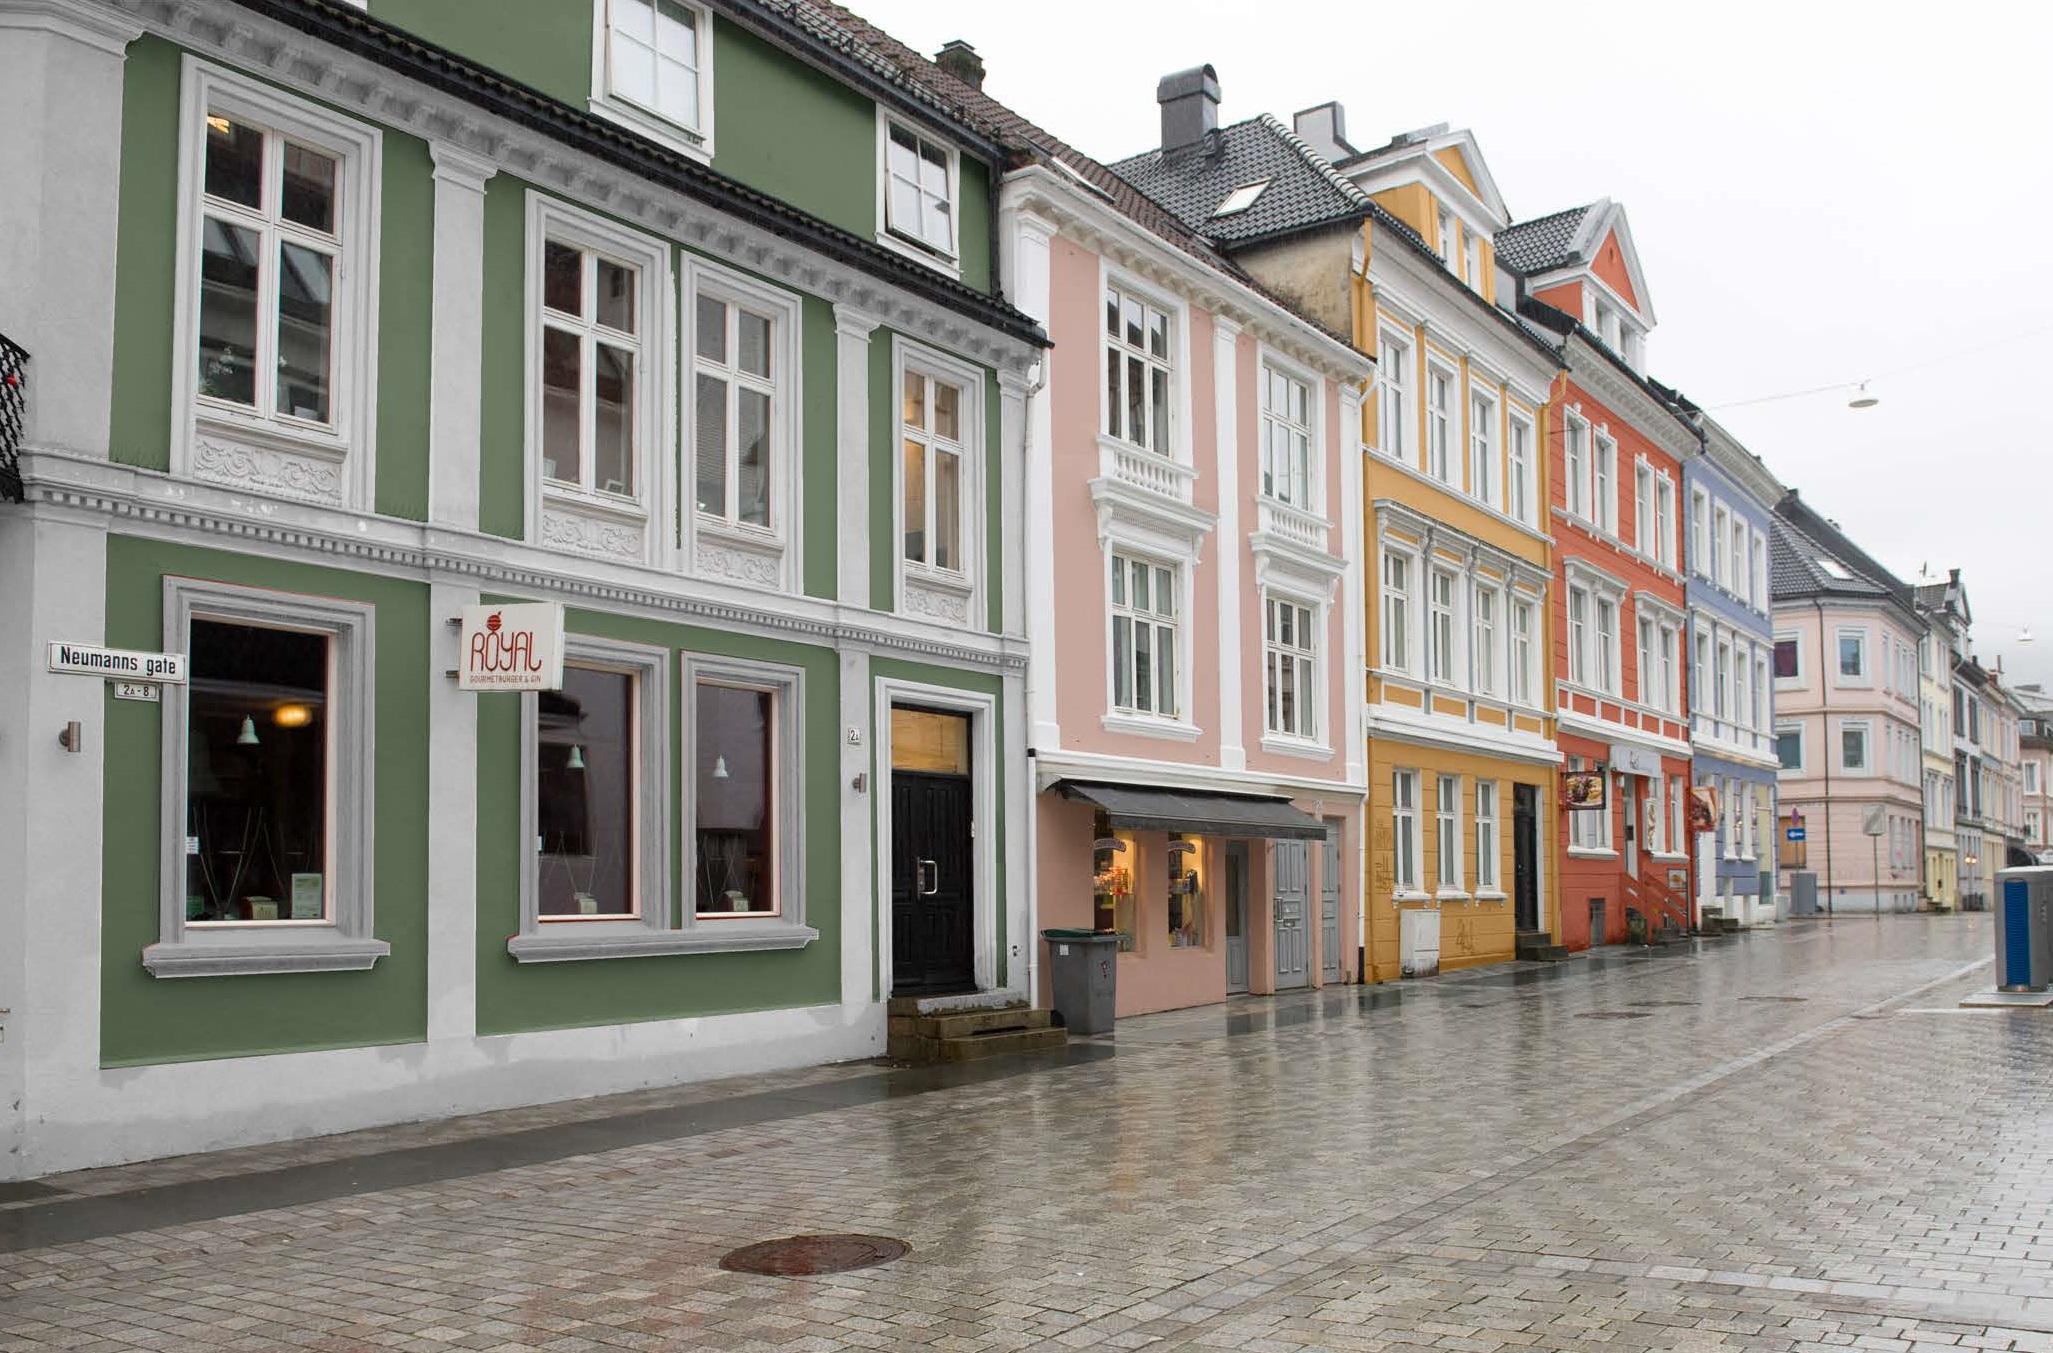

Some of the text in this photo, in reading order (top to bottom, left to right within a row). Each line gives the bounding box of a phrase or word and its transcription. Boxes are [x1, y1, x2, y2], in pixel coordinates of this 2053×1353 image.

[61, 646, 176, 676] Neumanns gate
[470, 631, 542, 672] ROYAL
